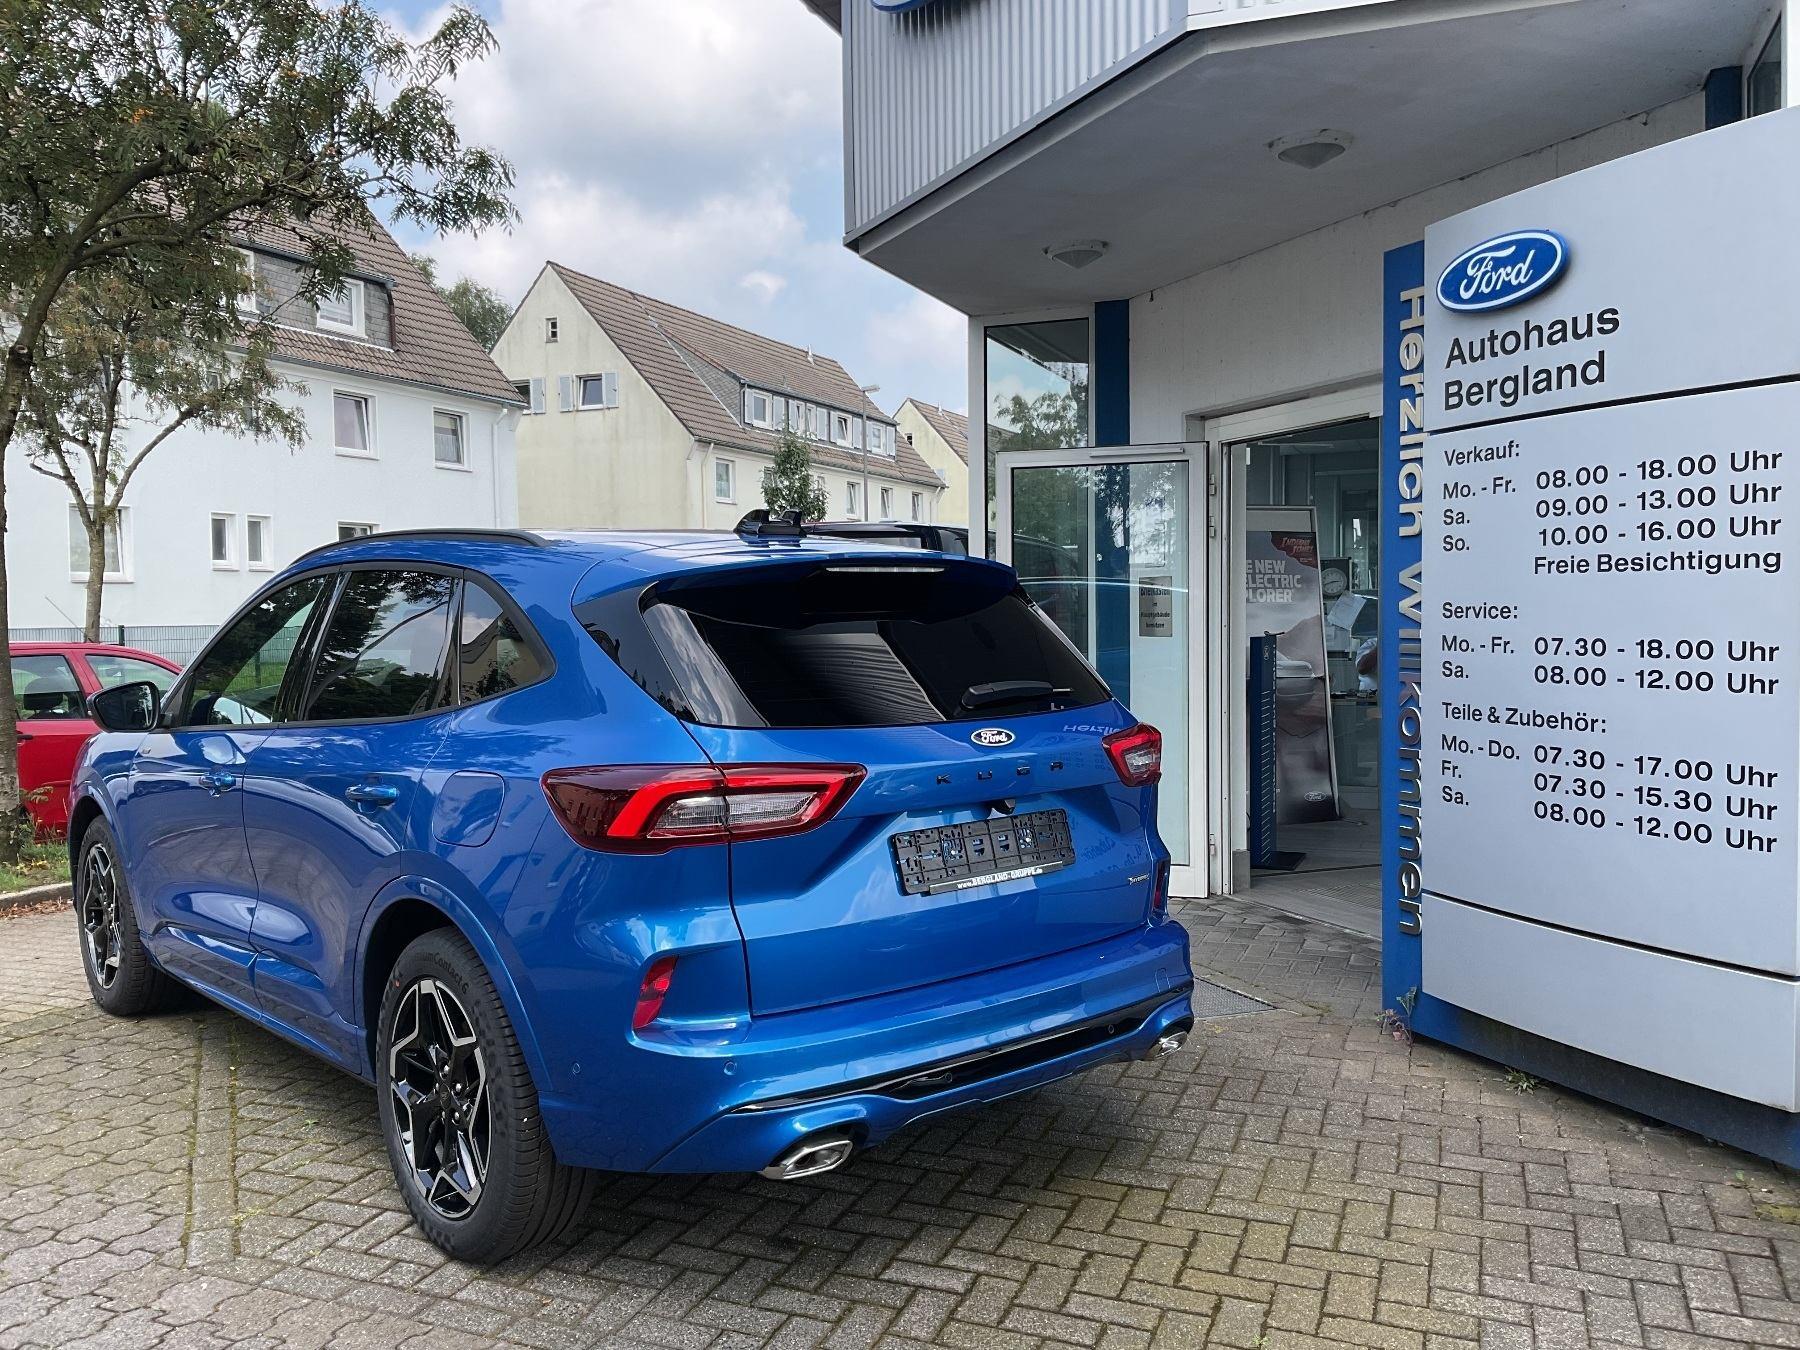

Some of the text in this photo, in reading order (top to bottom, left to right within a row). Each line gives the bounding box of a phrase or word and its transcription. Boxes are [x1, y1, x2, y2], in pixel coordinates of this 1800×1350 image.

[1458, 245, 1536, 299] Ford
[1443, 306, 1619, 371] Autohaus
[1445, 348, 1607, 413] Bergland
[1398, 287, 1426, 537] Herzlich
[1444, 440, 1519, 466] Verkauf:
[1443, 482, 1475, 499] Mo.
[1493, 477, 1515, 494] Fr.
[1537, 465, 1608, 489] 08.00
[1637, 455, 1716, 480] 18.00
[1731, 450, 1782, 472] Uhr
[1443, 509, 1470, 525] Sa.
[1536, 495, 1607, 518] 09.00
[1637, 487, 1715, 510] 13.00
[1730, 483, 1781, 504] Uhr
[1443, 535, 1469, 551] So.
[1539, 525, 1607, 546] 10.00
[1637, 518, 1715, 541] 16.00
[1730, 516, 1781, 537] Uhr
[1255, 560, 1286, 573] NEW
[1535, 550, 1780, 574] Freie Besichtigung
[1246, 575, 1302, 588] LECTRIC
[1443, 602, 1517, 619] Service:
[1442, 635, 1474, 652] Mo.
[1492, 637, 1514, 653] Fr.
[1535, 637, 1606, 657] 07.30
[1636, 639, 1713, 660] 18.00
[1728, 641, 1779, 661] Uhr
[1442, 661, 1468, 678] Sa.
[1535, 665, 1606, 686] 08.00
[1635, 670, 1713, 691] 12.00
[1728, 673, 1779, 694] Uhr
[981, 728, 1007, 743] Ford
[1442, 702, 1605, 733] Teile & Zubehör:
[1398, 561, 1422, 936] Willkommen
[1442, 734, 1473, 754] Mo.
[1489, 740, 1519, 760] Do.
[1534, 745, 1605, 769] 07.30
[1635, 756, 1712, 781] 17.00
[1727, 764, 1778, 787] Uhr
[1442, 760, 1461, 778] Fr.
[1534, 773, 1605, 799] 07.30
[1634, 786, 1711, 812] 15.30
[1727, 796, 1777, 820] Uhr
[1442, 786, 1468, 805] Sa.
[1534, 801, 1605, 828] 08.00
[1634, 816, 1712, 843] 12.00
[1726, 828, 1777, 852] Uhr
